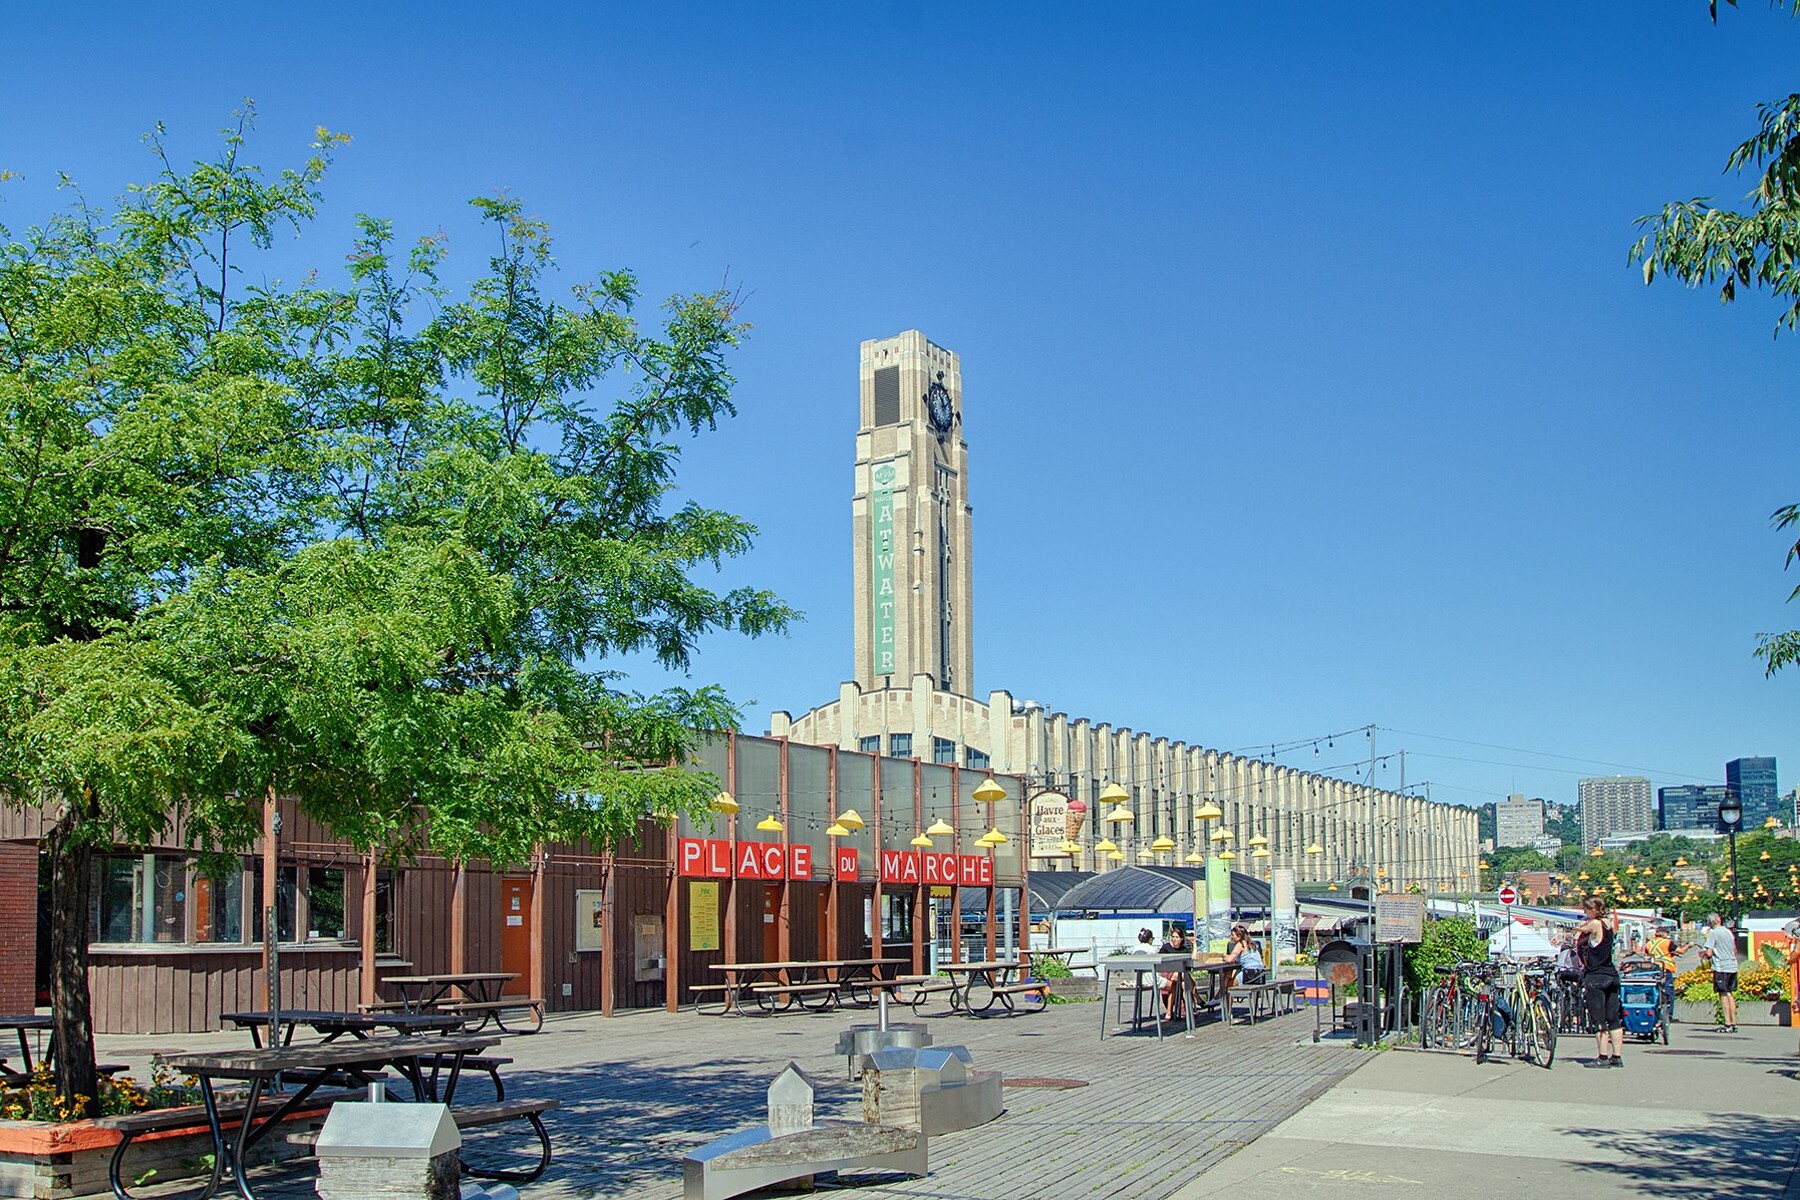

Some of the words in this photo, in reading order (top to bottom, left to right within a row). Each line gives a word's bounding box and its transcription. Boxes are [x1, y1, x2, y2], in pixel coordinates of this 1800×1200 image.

[878, 505, 893, 668] ATWATER
[1036, 805, 1064, 815] Havre
[1035, 825, 1065, 836] Glaces
[684, 842, 808, 876] PLACE
[841, 857, 856, 873] DU
[884, 853, 991, 882] MARCHÉ
